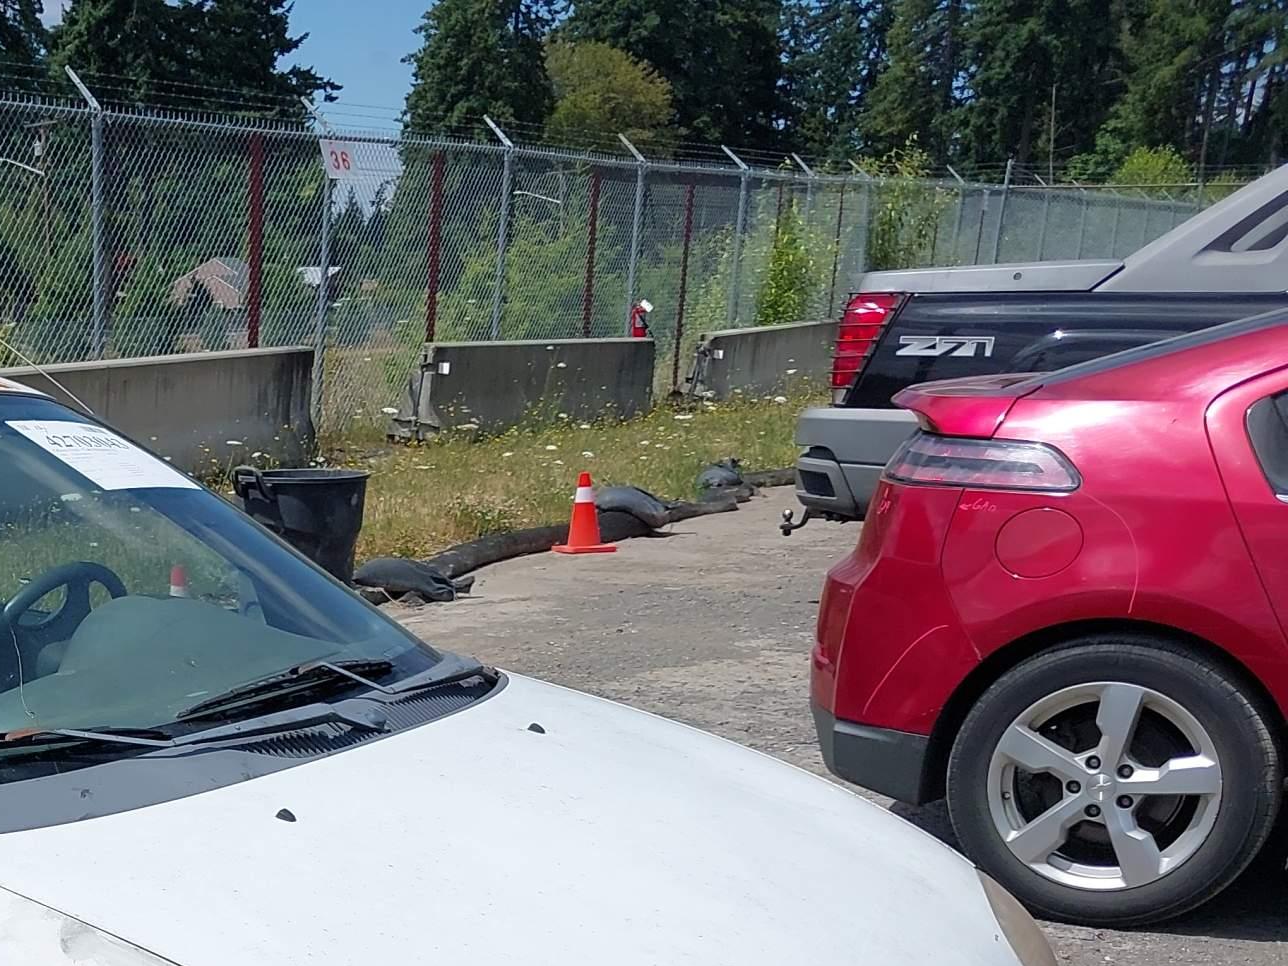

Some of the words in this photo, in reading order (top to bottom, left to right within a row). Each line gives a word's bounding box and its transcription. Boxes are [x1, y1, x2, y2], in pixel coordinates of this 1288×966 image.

[330, 151, 350, 169] 36
[896, 336, 995, 356] Z71
[46, 436, 129, 449] 42703043
